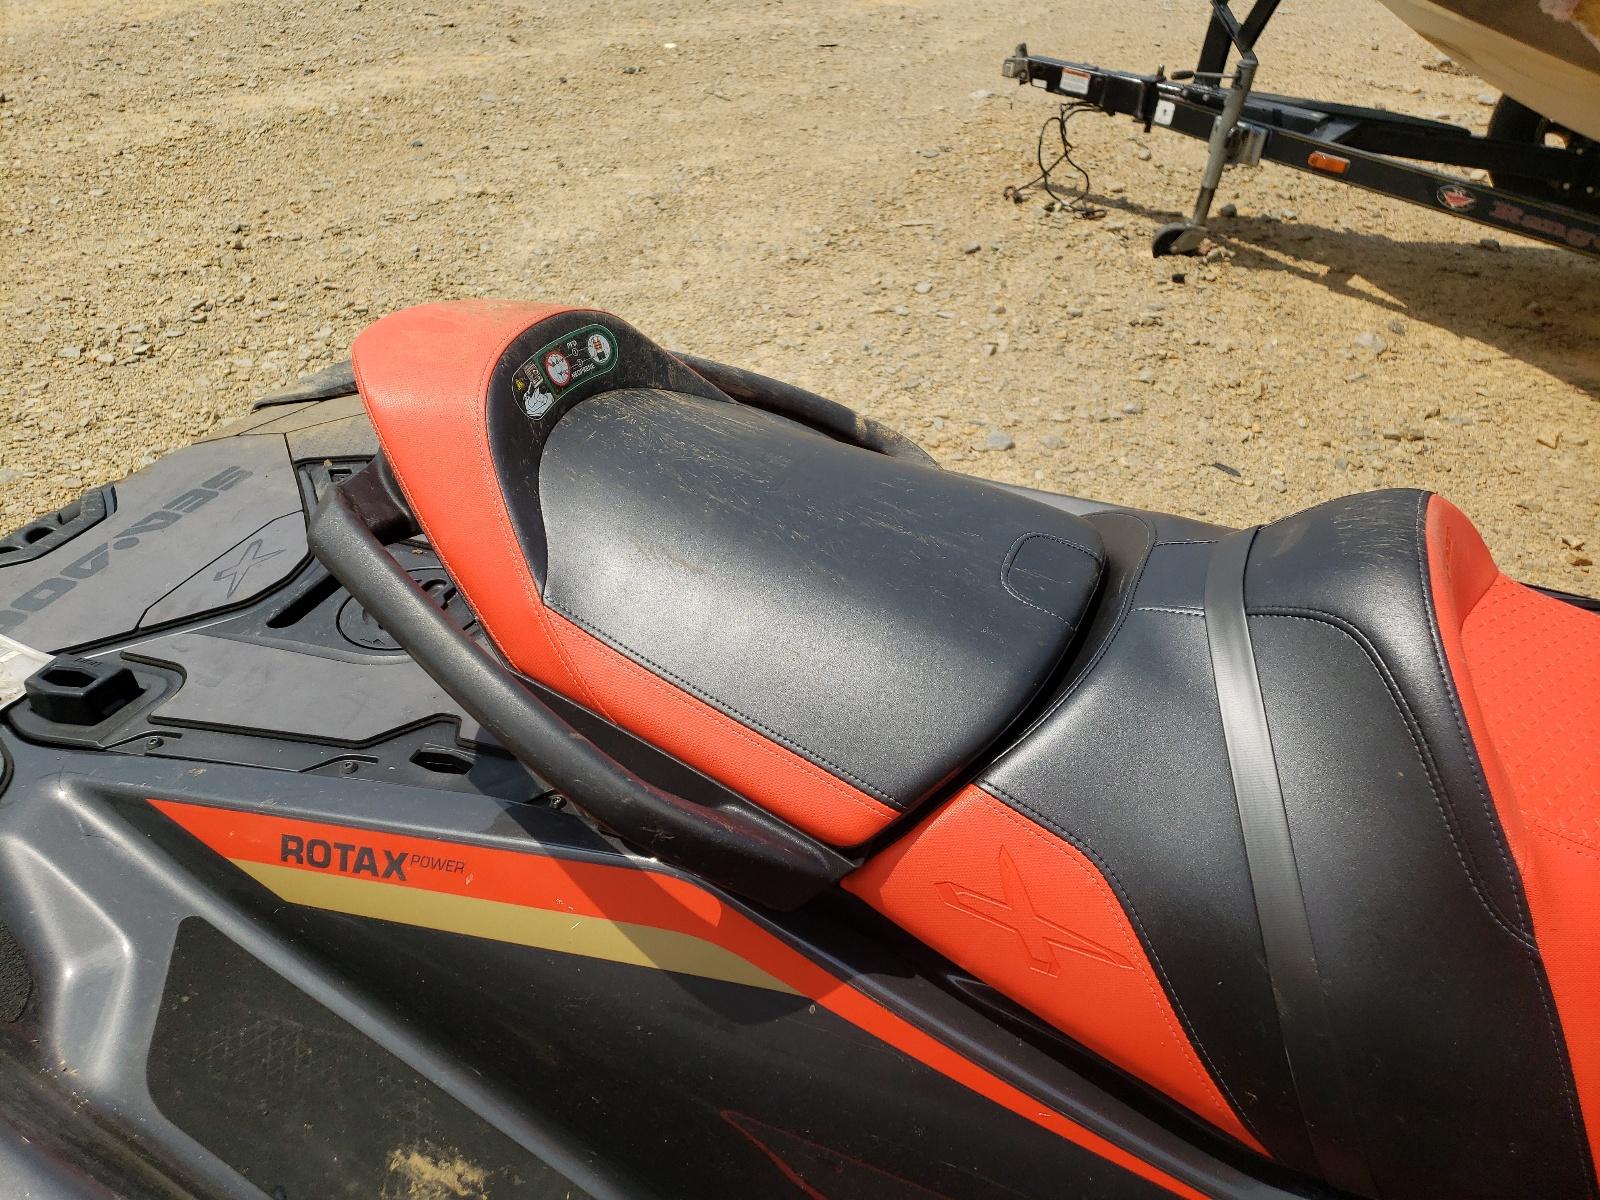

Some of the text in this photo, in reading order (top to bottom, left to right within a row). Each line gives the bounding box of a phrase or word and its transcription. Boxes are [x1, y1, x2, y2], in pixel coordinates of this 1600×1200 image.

[567, 340, 577, 349] PFD
[571, 363, 596, 378] NEOPRENE
[280, 833, 465, 882] ROTAX POWER
